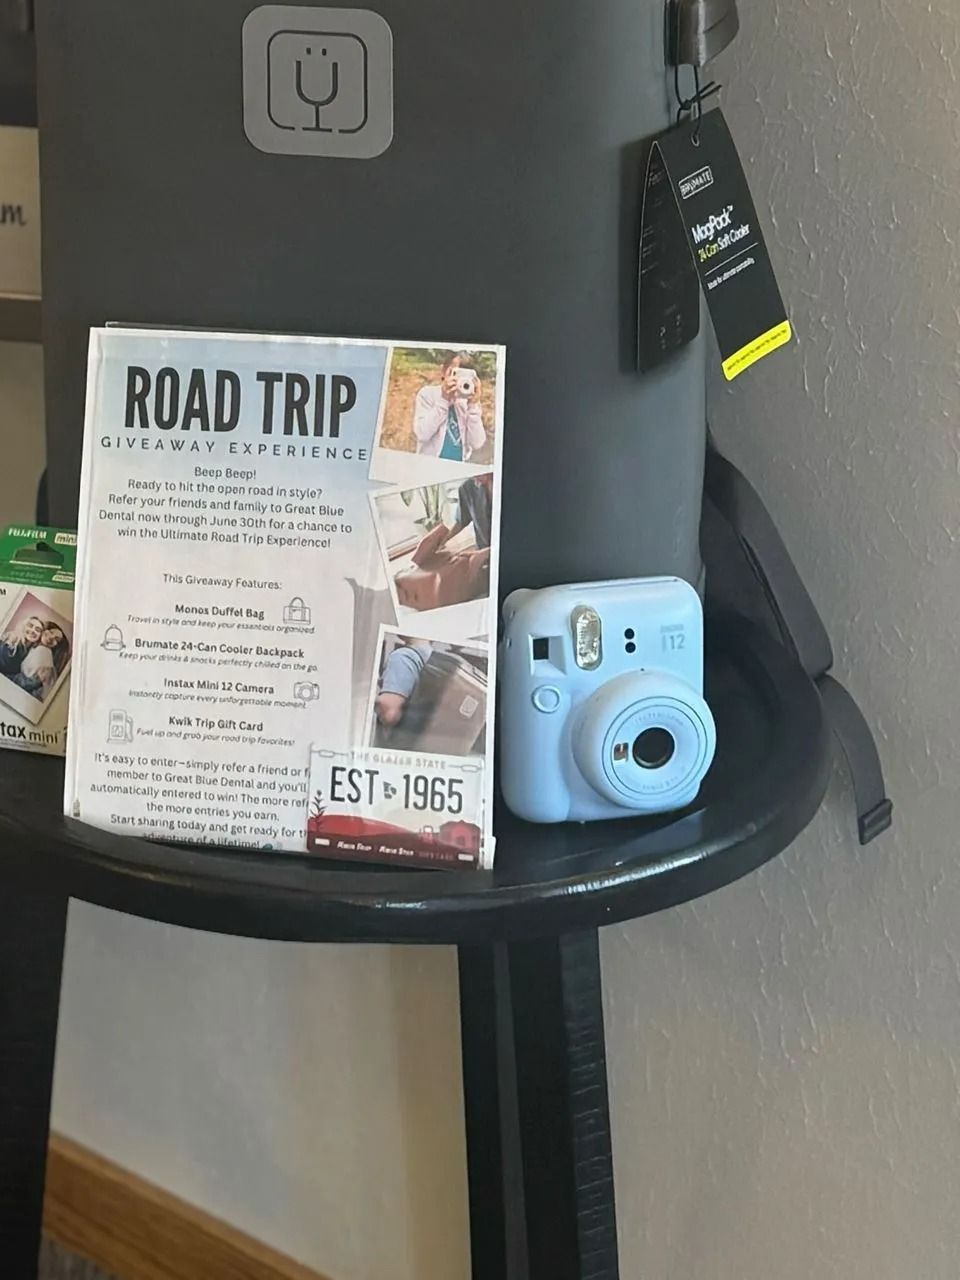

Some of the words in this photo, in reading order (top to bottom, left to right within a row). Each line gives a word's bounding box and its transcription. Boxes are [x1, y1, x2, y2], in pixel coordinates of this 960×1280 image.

[125, 366, 241, 432] ROAD
[256, 371, 357, 438] TRIP
[101, 436, 215, 453] GIVEAWAY
[229, 442, 367, 460] EXPERIENCE
[194, 466, 222, 479] Beep
[226, 468, 256, 480] Beep!
[128, 479, 161, 493] Ready
[165, 481, 176, 491] to
[180, 482, 193, 492] hit
[197, 482, 215, 493] the
[218, 485, 245, 496] open
[249, 486, 273, 496] road
[277, 487, 286, 496] in
[290, 488, 323, 500] style?
[109, 494, 138, 505] Refer
[140, 497, 166, 508] your
[169, 497, 207, 509] friends
[210, 500, 230, 510] and
[234, 500, 268, 515] family
[271, 504, 282, 513] to
[285, 503, 315, 515] Great
[319, 505, 344, 516] Blue
[99, 509, 134, 521] Dental
[138, 513, 160, 522] now
[164, 513, 207, 527] through
[210, 516, 237, 526] June
[240, 517, 266, 528] 30th
[269, 518, 285, 529] for
[297, 521, 337, 532] chance
[341, 524, 352, 533] to
[8, 528, 47, 539] FUJIFILM
[118, 527, 136, 537] win
[140, 528, 157, 538] the
[160, 529, 208, 541] Ultimate
[211, 531, 239, 543] Road
[242, 533, 264, 545] Trip
[267, 535, 330, 548] Experience!
[163, 573, 183, 584] This
[185, 575, 233, 588] Giveaway
[236, 578, 282, 590] Features:
[175, 604, 209, 615] Monos
[212, 606, 243, 617] Duffel
[246, 609, 265, 620] Bag
[135, 638, 179, 650] Brumate
[220, 644, 253, 655] Cooler
[256, 646, 304, 659] Backpack
[164, 678, 194, 689] Instax
[197, 680, 219, 690] Mini
[221, 681, 232, 691] 12
[235, 682, 274, 694] Camera
[169, 716, 193, 726] Kwik
[195, 718, 215, 729] Trip
[218, 719, 236, 730] Gift
[239, 721, 263, 731] Card
[29, 730, 58, 744] mini
[94, 753, 109, 762] It's
[112, 755, 135, 766] easy
[138, 757, 148, 765] to
[222, 763, 246, 772] refer
[257, 764, 288, 776] friend
[291, 768, 301, 776] or
[416, 758, 446, 769] STATE
[107, 769, 149, 780] member
[152, 772, 162, 781] to
[165, 773, 192, 784] Great
[195, 775, 218, 785] Blue
[221, 777, 254, 788] Dental
[257, 780, 275, 790] and
[279, 782, 307, 793] you'll
[330, 766, 379, 805] EST
[403, 774, 464, 814] 1965
[90, 784, 159, 798] automatically
[162, 790, 201, 799] entered
[204, 791, 215, 800] to
[217, 792, 238, 802] win!
[241, 794, 259, 804] The
[262, 798, 289, 806] more
[147, 802, 163, 812] the
[166, 805, 192, 814] more
[194, 807, 230, 817] entries
[233, 810, 251, 820] you
[254, 812, 279, 821] earn.
[110, 814, 135, 826] Start
[138, 816, 174, 830] sharing
[177, 820, 206, 833] today
[209, 821, 228, 832] and
[231, 825, 246, 835] get
[249, 826, 279, 838] ready
[282, 827, 295, 837] for
